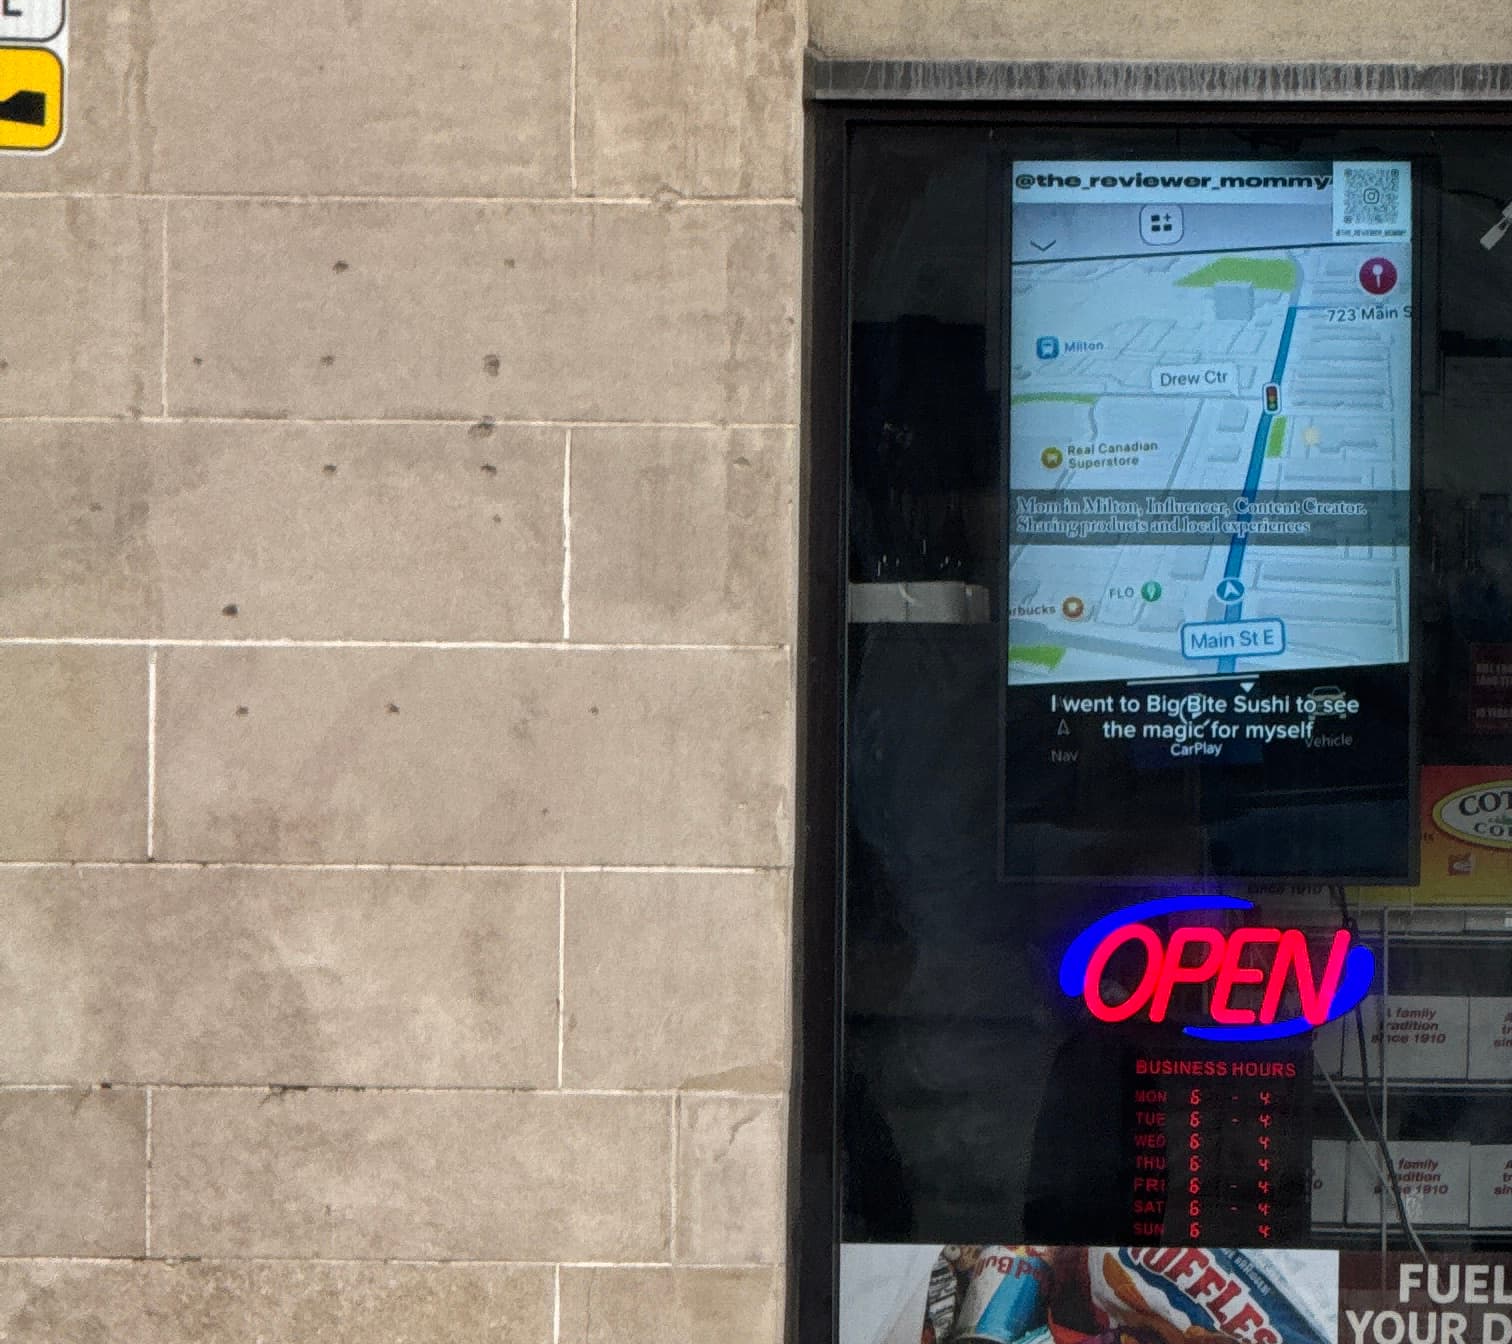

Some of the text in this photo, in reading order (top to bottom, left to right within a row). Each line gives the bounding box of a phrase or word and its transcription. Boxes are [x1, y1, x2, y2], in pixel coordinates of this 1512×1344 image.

[1015, 173, 1332, 191] @the_reviewer_mommy
[1327, 308, 1356, 322] 723
[1361, 306, 1398, 321] Main
[1064, 340, 1104, 353] Milton
[1160, 370, 1228, 387] Drew Ctr
[1067, 441, 1158, 455] Real Canadian
[1068, 455, 1139, 469] Superstore
[1016, 496, 1367, 517] Mom in Milton, Influencer, Content Creator.
[1016, 516, 1310, 538] Sharing products and local experiences
[1109, 587, 1134, 599] FLO
[1191, 630, 1274, 649] Main St E
[1063, 699, 1114, 713] went
[1118, 699, 1139, 713] to
[1146, 697, 1179, 717] Big
[1187, 696, 1227, 712] Bite
[1234, 696, 1289, 712] Sushi
[1296, 698, 1316, 713] to
[1322, 700, 1359, 713] see
[1103, 721, 1313, 744] the magic for myself
[1305, 733, 1353, 748] Vehicle
[1051, 749, 1078, 763] Nav
[1170, 741, 1222, 758] CarPlay
[1084, 924, 1351, 1026] OPEN
[1396, 1008, 1437, 1020] family
[1414, 1034, 1446, 1044] 1910
[1135, 1059, 1297, 1077] BUSINESS HOURS
[1135, 1089, 1273, 1105] MON 6 4
[1135, 1111, 1273, 1128] TUE 6 4
[1135, 1133, 1271, 1150] WED 6 4
[1135, 1155, 1271, 1172] THU 6 4
[1399, 1158, 1438, 1171] family
[1133, 1177, 1271, 1194] FRI 6 4
[1133, 1200, 1271, 1216] SAT 6 4
[1133, 1222, 1271, 1239] SUN 6 4
